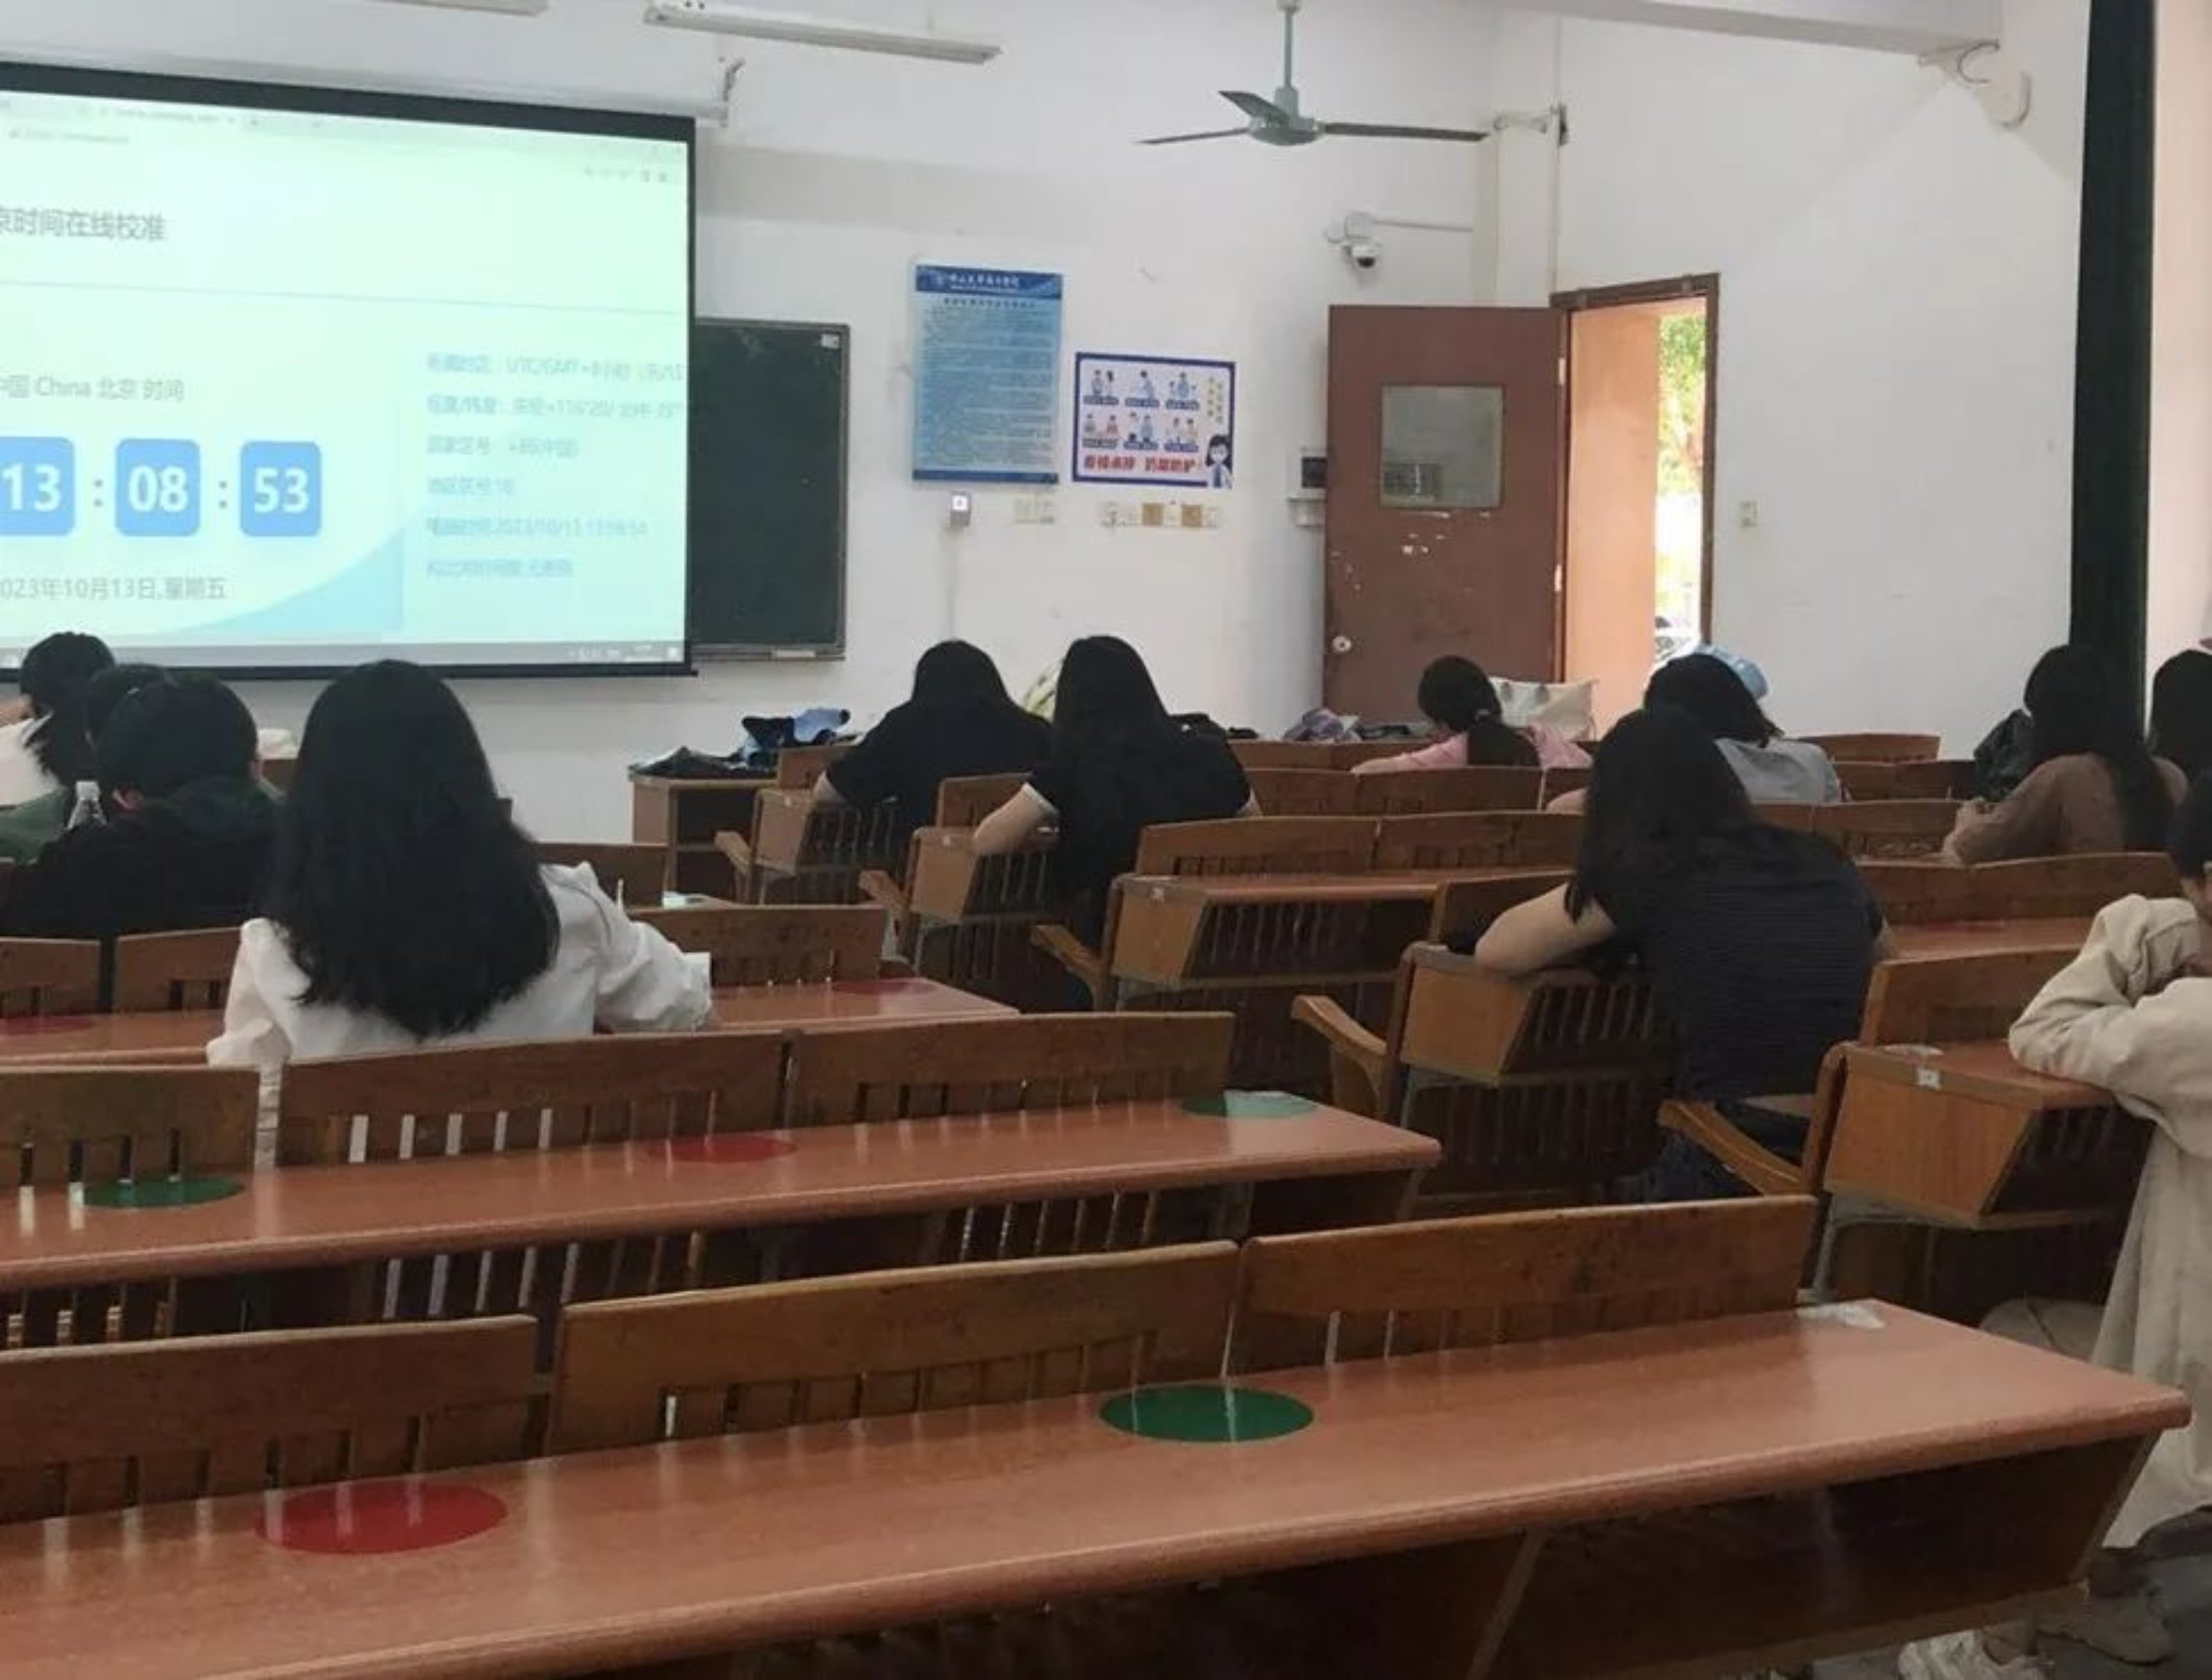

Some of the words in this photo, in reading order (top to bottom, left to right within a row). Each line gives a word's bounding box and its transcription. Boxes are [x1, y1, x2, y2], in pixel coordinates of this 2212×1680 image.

[36, 375, 91, 397] China
[97, 377, 137, 399] 北京
[143, 378, 184, 401] 时间
[2, 463, 61, 511] 13
[128, 465, 188, 512] 08
[254, 466, 308, 512] 53
